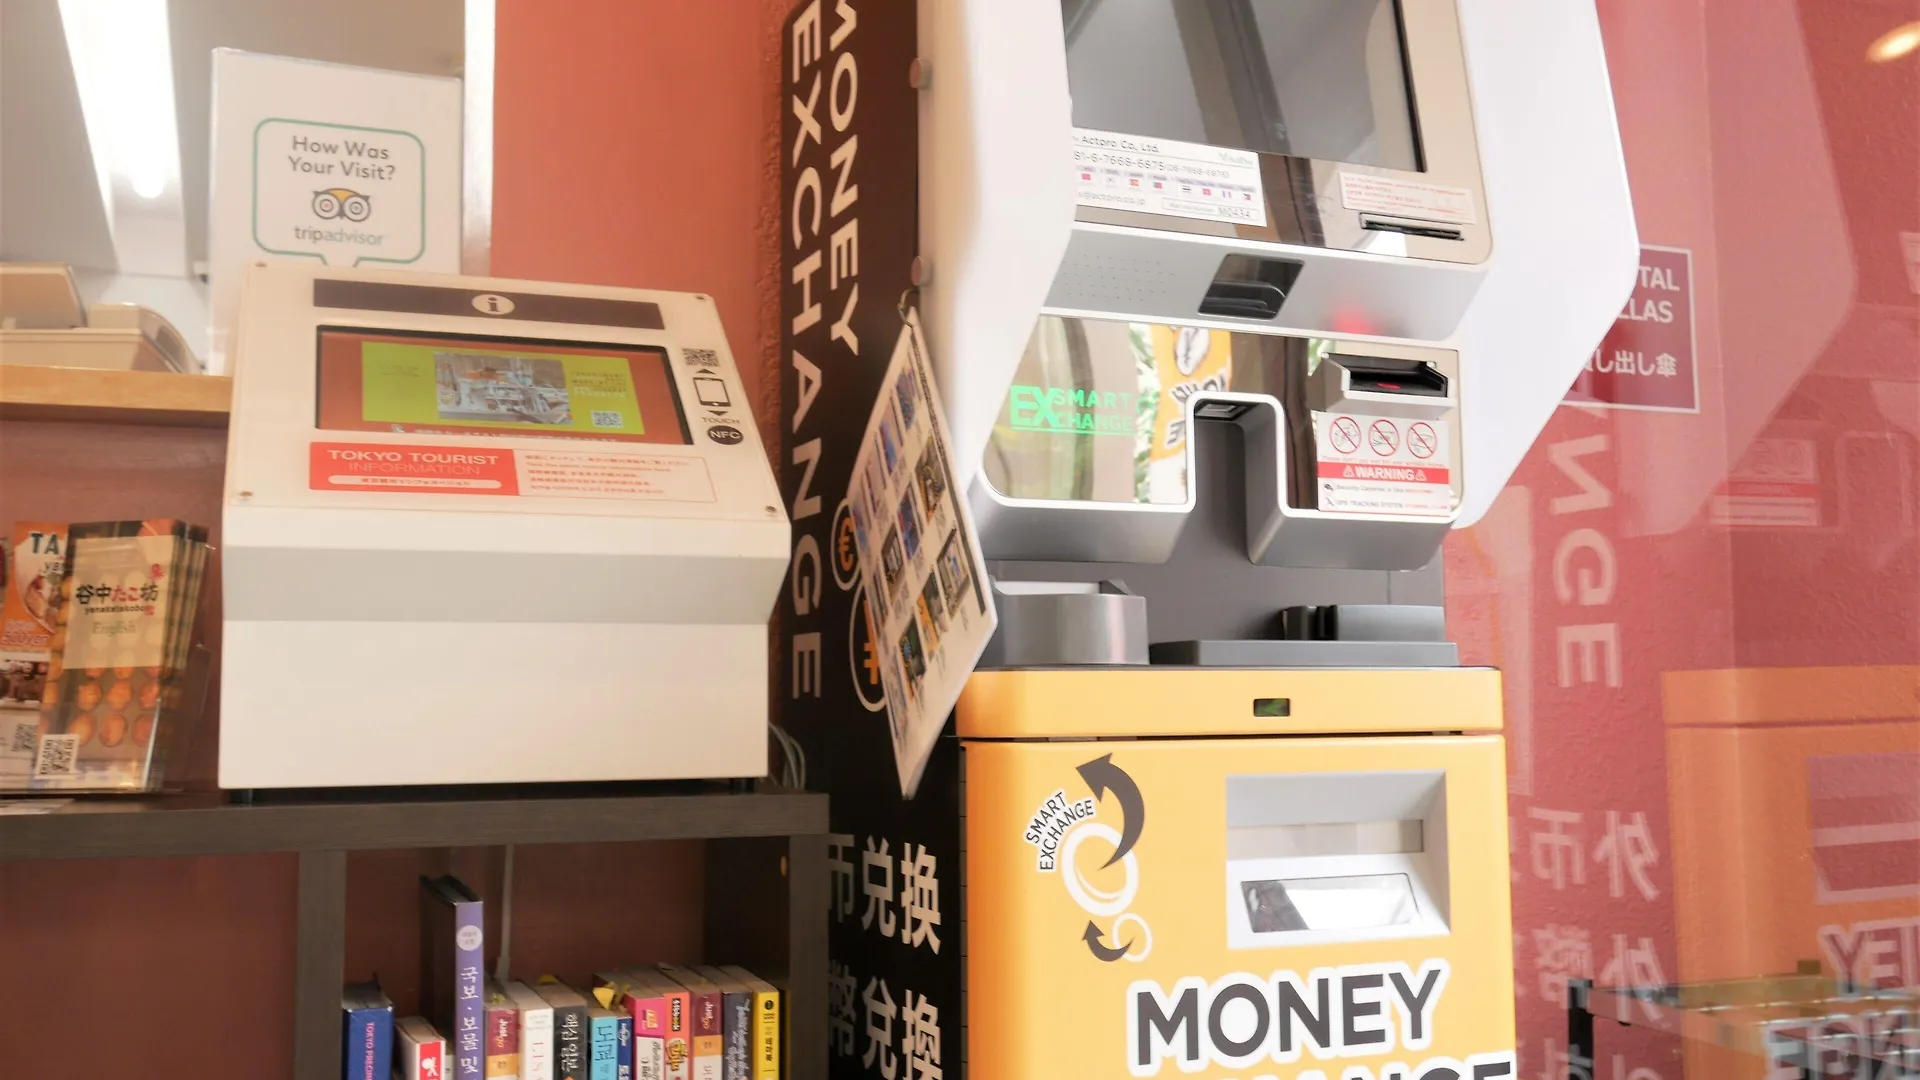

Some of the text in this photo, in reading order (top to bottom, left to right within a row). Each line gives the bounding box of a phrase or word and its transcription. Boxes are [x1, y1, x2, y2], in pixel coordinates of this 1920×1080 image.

[292, 135, 389, 160] How Was
[288, 155, 396, 181] Your Visit?
[293, 225, 384, 246] tripadvisor
[1638, 265, 1681, 292] TAL
[792, 0, 822, 699] EXCHANGE
[1054, 387, 1133, 409] SMART
[710, 430, 740, 440] NFC
[328, 450, 499, 465] TOKYO TOURIST
[349, 462, 481, 475] INFORMATION
[1354, 465, 1415, 481] WARNING
[75, 584, 158, 605] 谷中たこ坊
[92, 620, 136, 635] English
[1026, 791, 1066, 844] SMART
[1040, 799, 1094, 870] EXCHANGE
[1137, 969, 1441, 1066] MONEY
[365, 1022, 375, 1048] TOKYO
[560, 1043, 579, 1073] 일본
